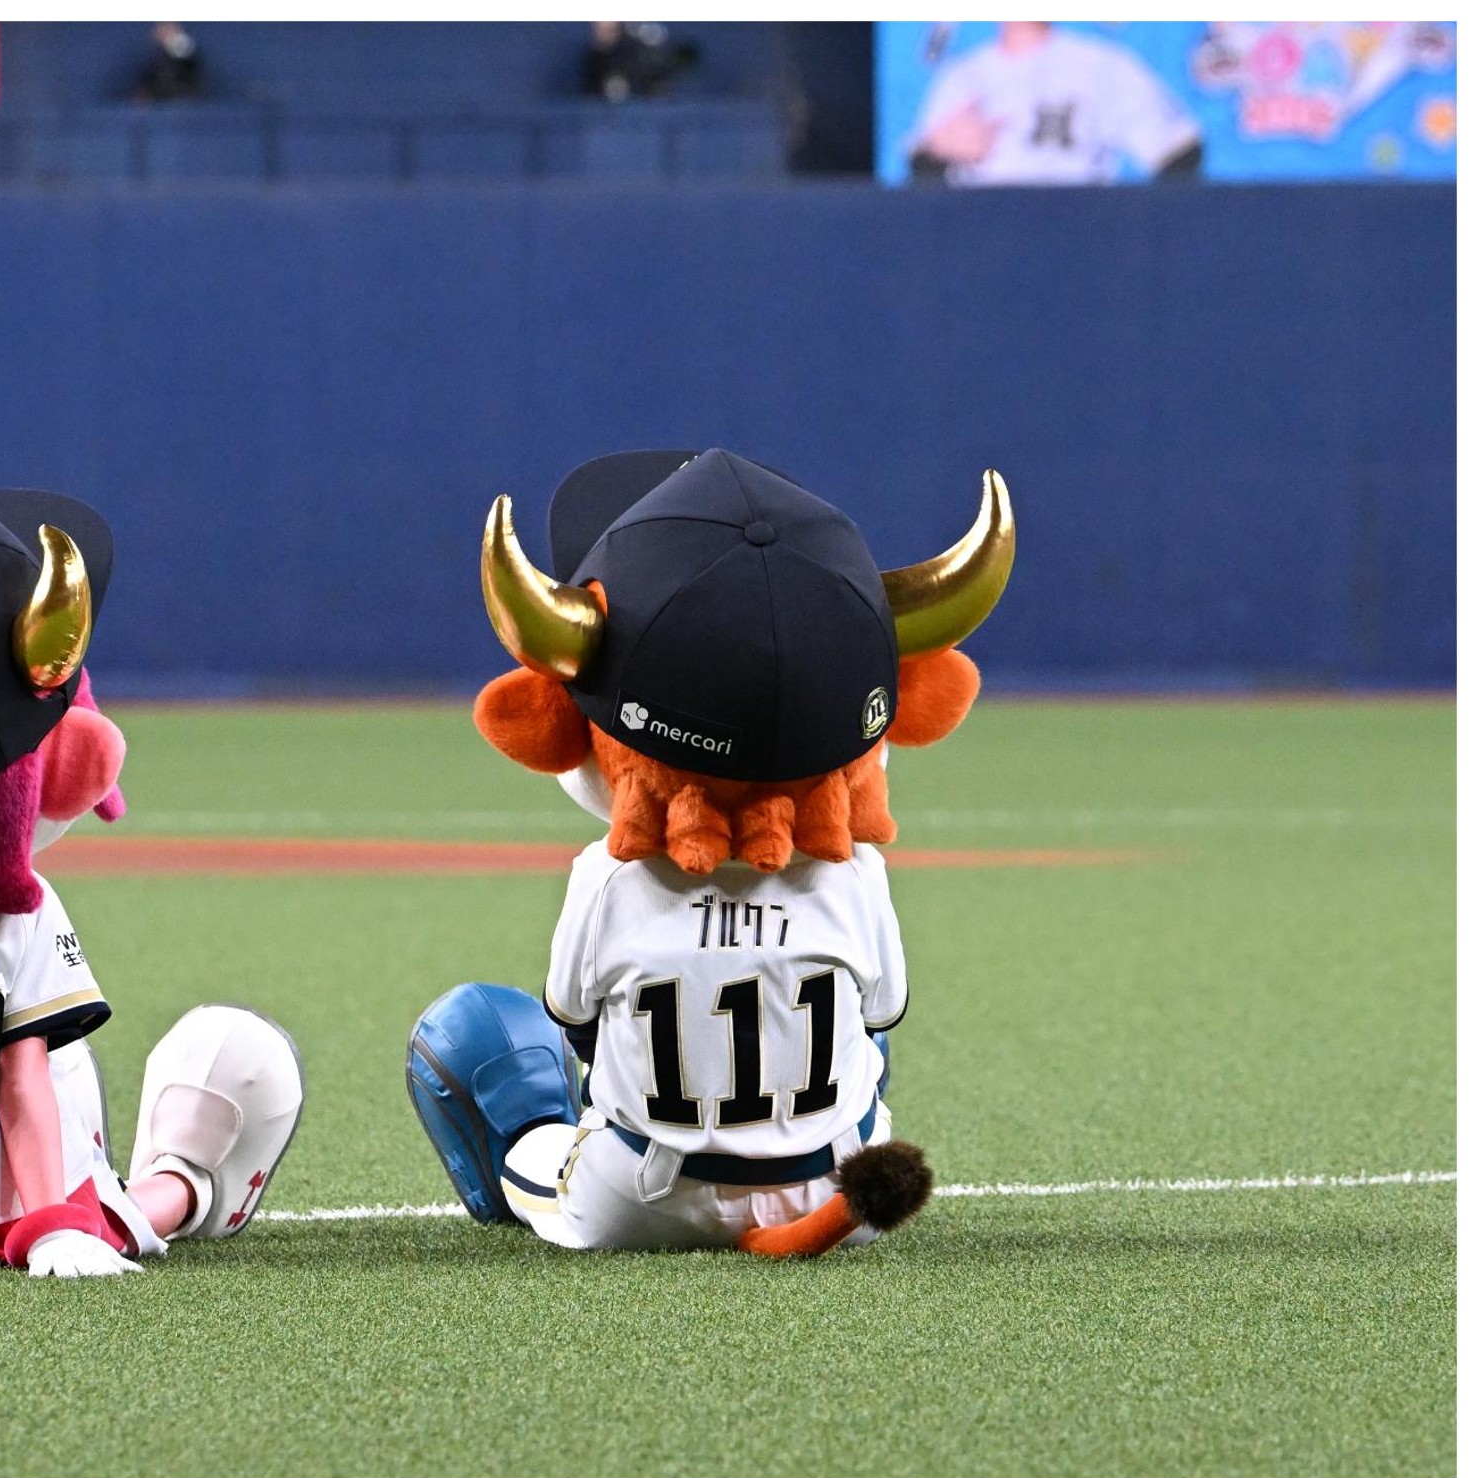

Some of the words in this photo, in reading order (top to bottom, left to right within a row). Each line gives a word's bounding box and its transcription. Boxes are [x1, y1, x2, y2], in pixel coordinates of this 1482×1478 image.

[649, 720, 733, 755] mercari
[56, 932, 78, 952] FW
[632, 966, 840, 1130] 111
